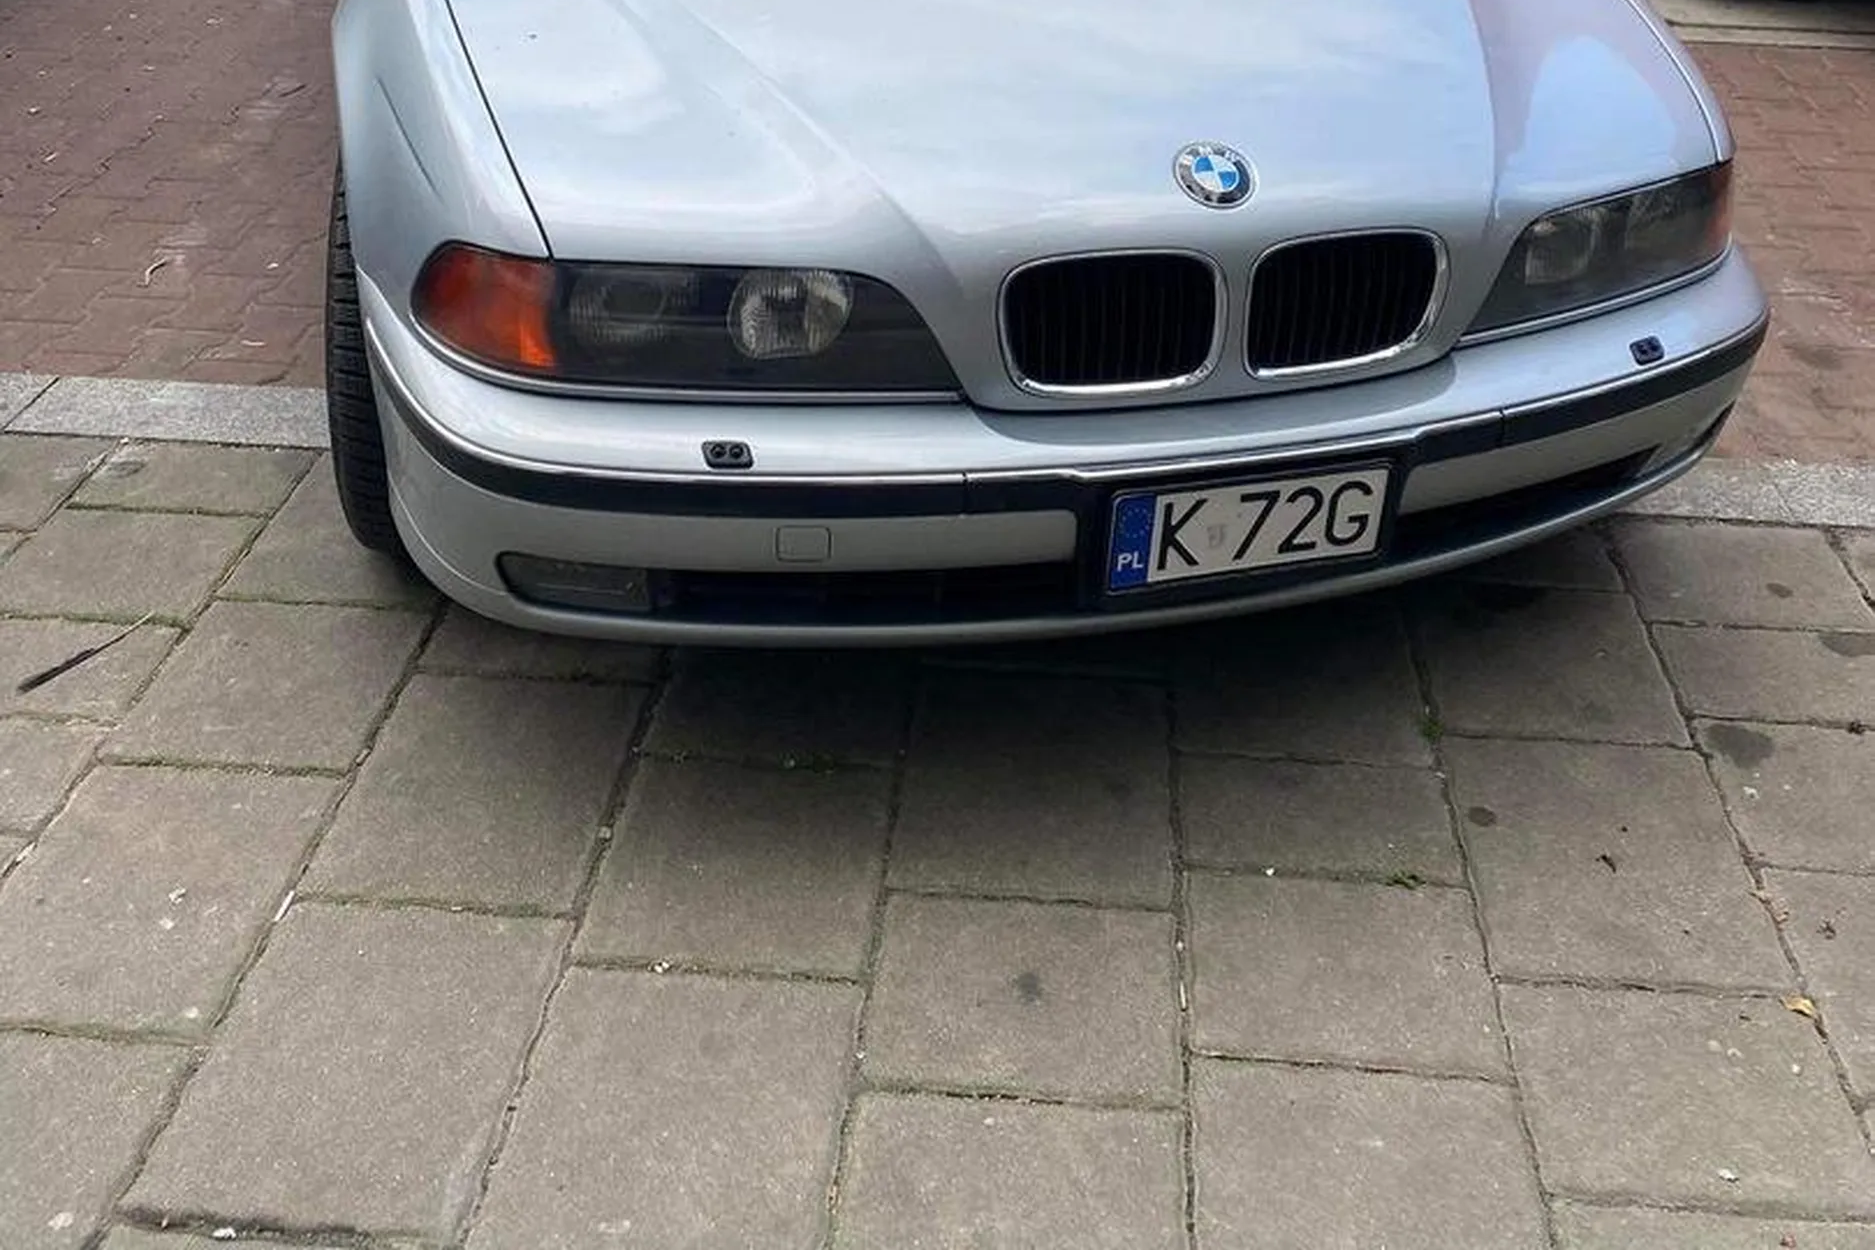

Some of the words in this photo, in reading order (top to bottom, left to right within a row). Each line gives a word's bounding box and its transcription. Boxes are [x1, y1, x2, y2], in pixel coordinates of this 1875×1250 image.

[1157, 499, 1208, 571] K
[1232, 480, 1374, 561] 72G
[1116, 551, 1144, 572] PL
